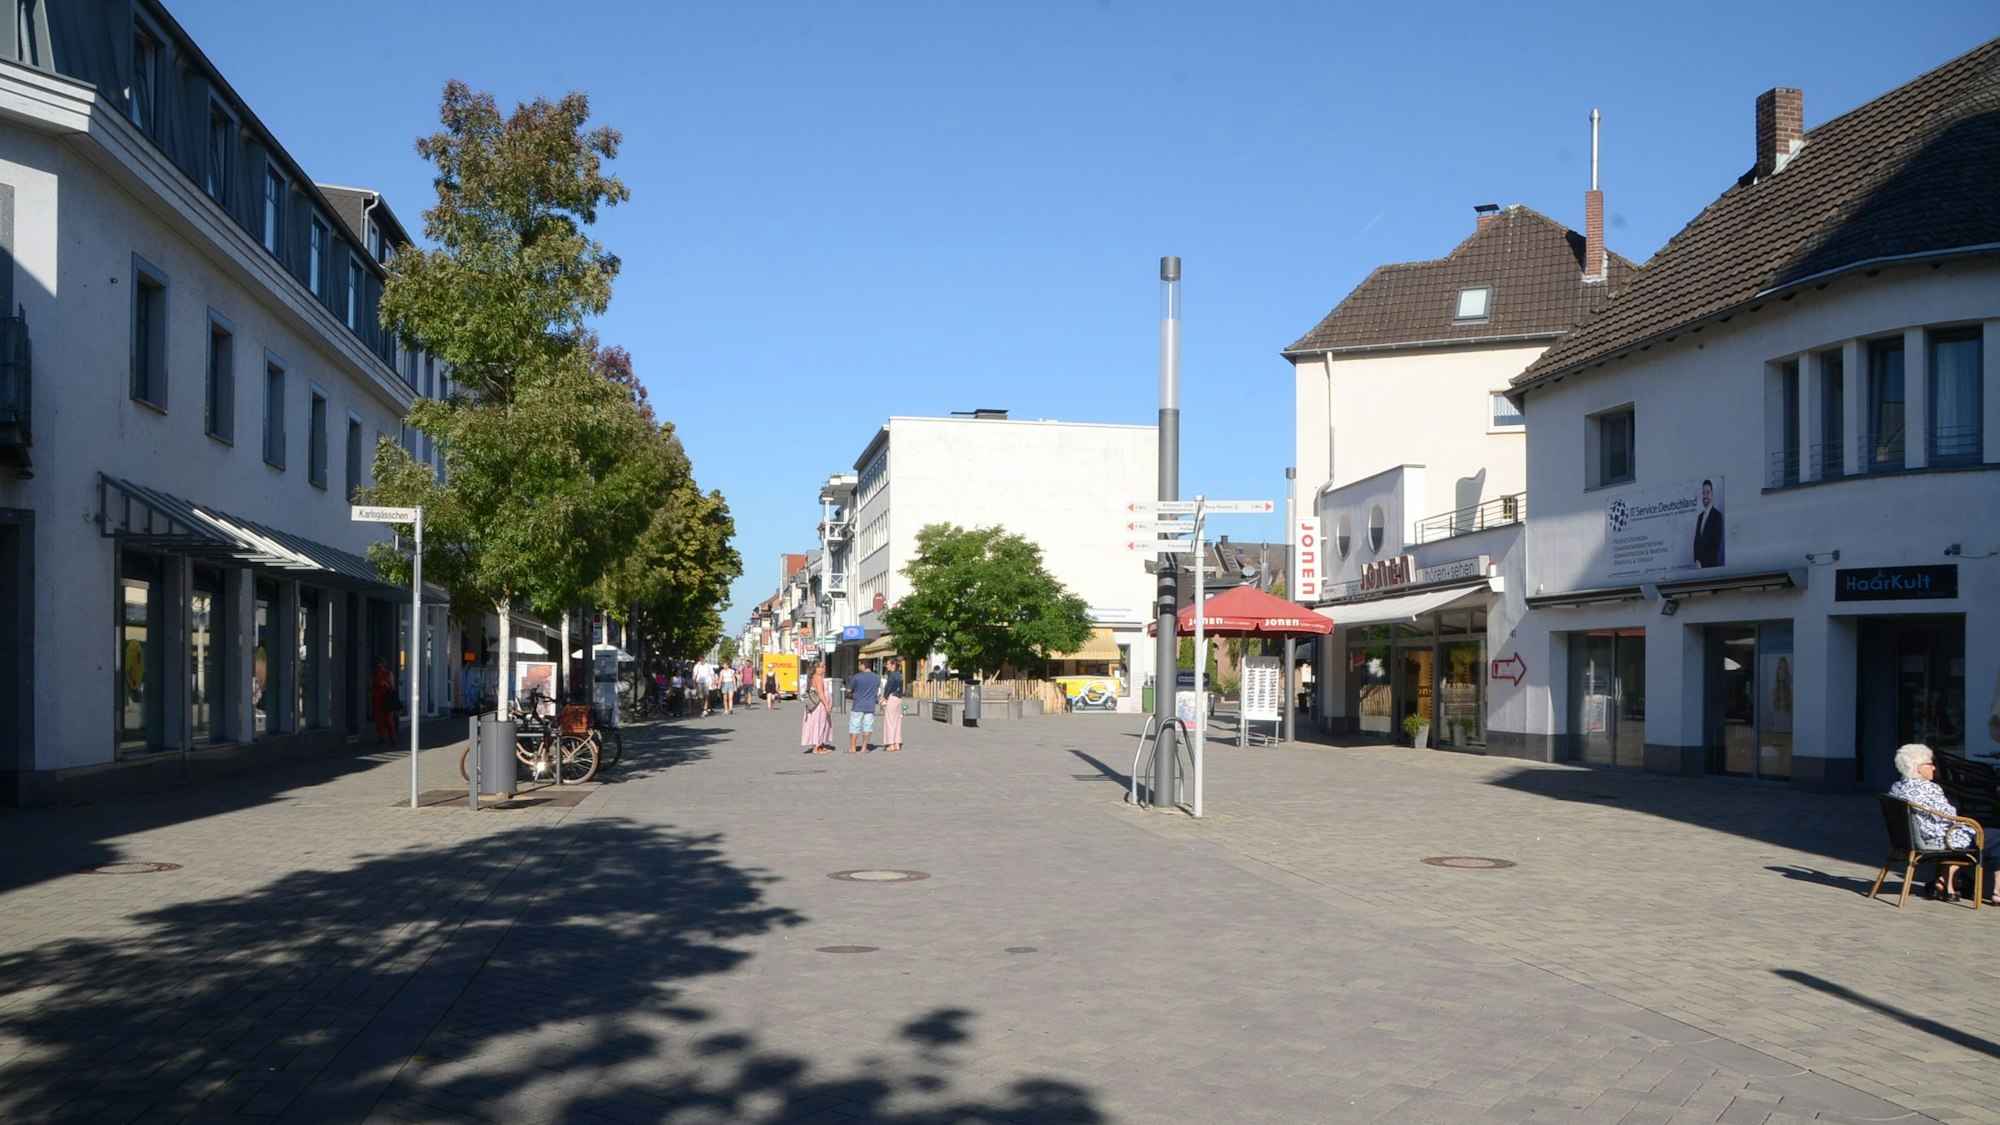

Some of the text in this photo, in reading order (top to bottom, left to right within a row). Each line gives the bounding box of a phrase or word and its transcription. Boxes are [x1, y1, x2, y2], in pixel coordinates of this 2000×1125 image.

[359, 509, 409, 520] Karlsgässchen
[1631, 507, 1637, 517] IT
[1636, 505, 1658, 517] Service
[1658, 496, 1698, 513] Deutschland
[1846, 574, 1931, 590] HaarKult
